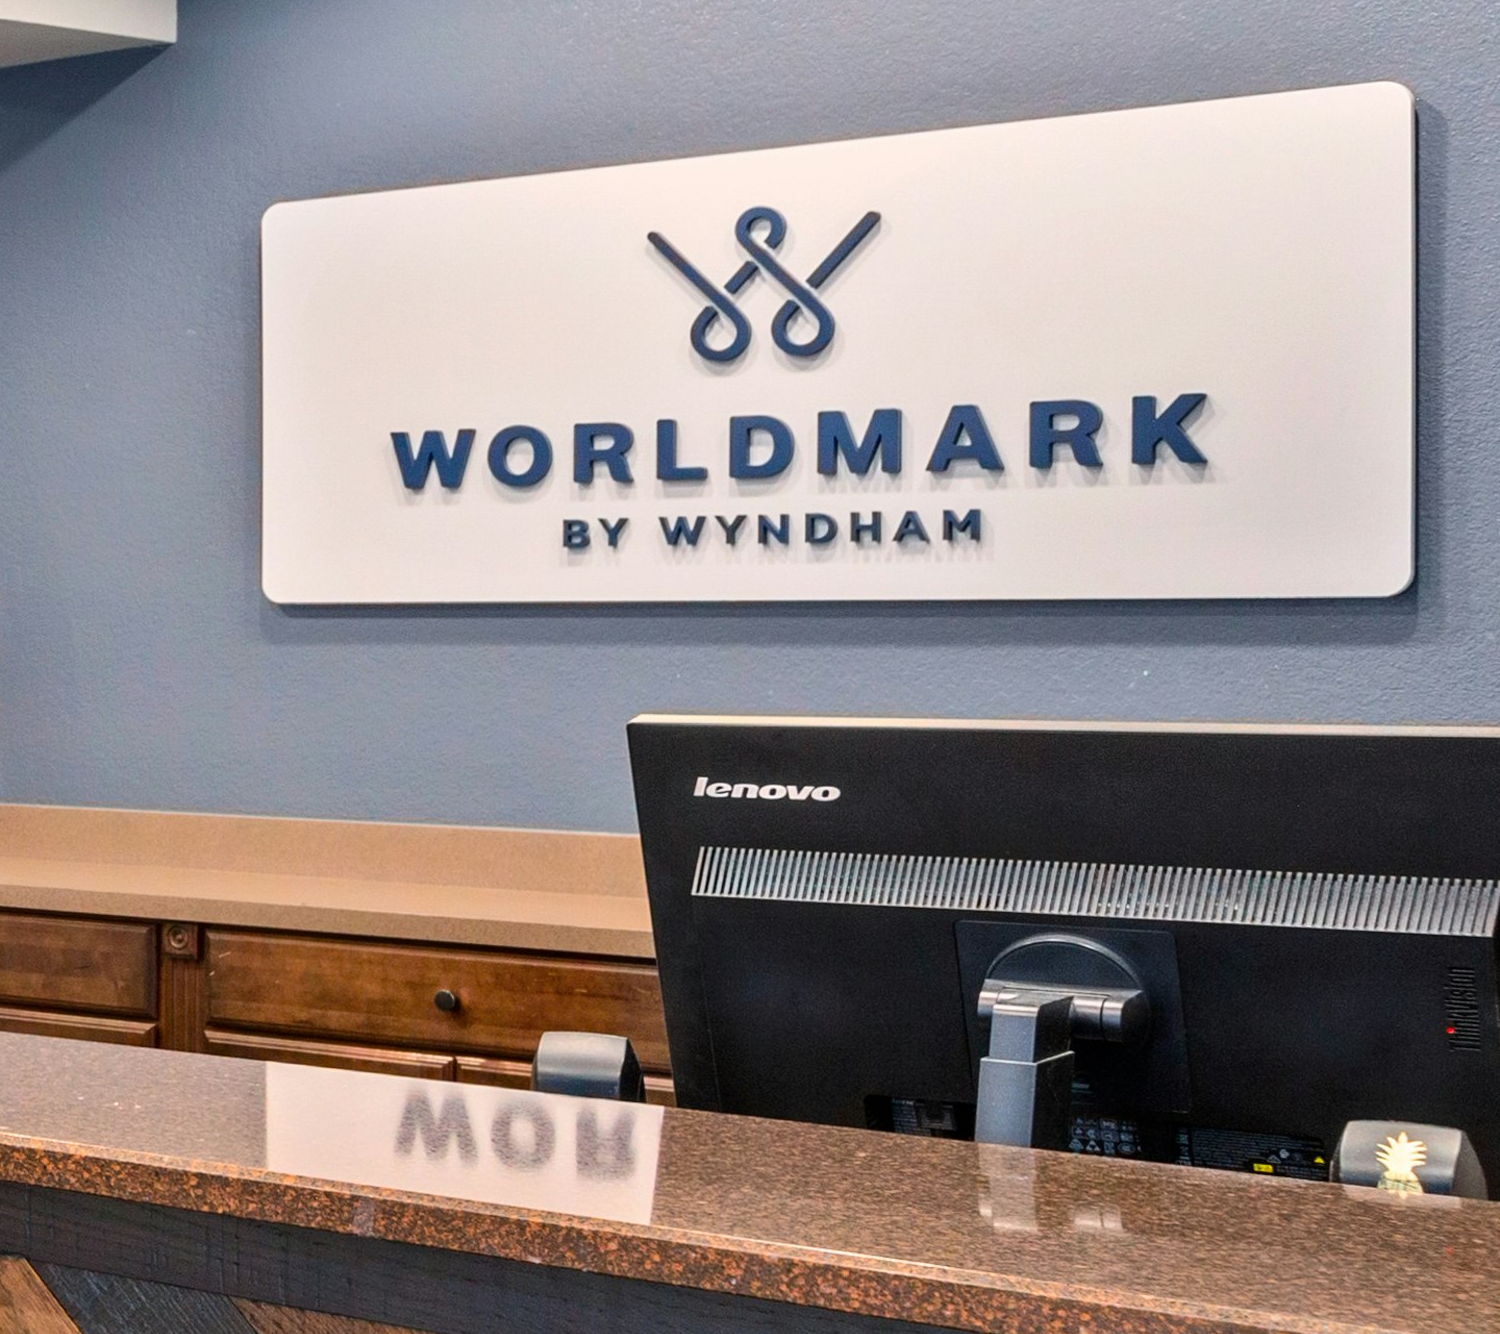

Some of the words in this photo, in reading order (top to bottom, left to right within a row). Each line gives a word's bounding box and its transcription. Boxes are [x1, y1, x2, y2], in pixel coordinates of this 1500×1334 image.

[390, 393, 1208, 490] WORLDMARK
[562, 516, 629, 550] BY
[659, 507, 983, 548] WYNDHAM
[693, 777, 841, 802] lenovo
